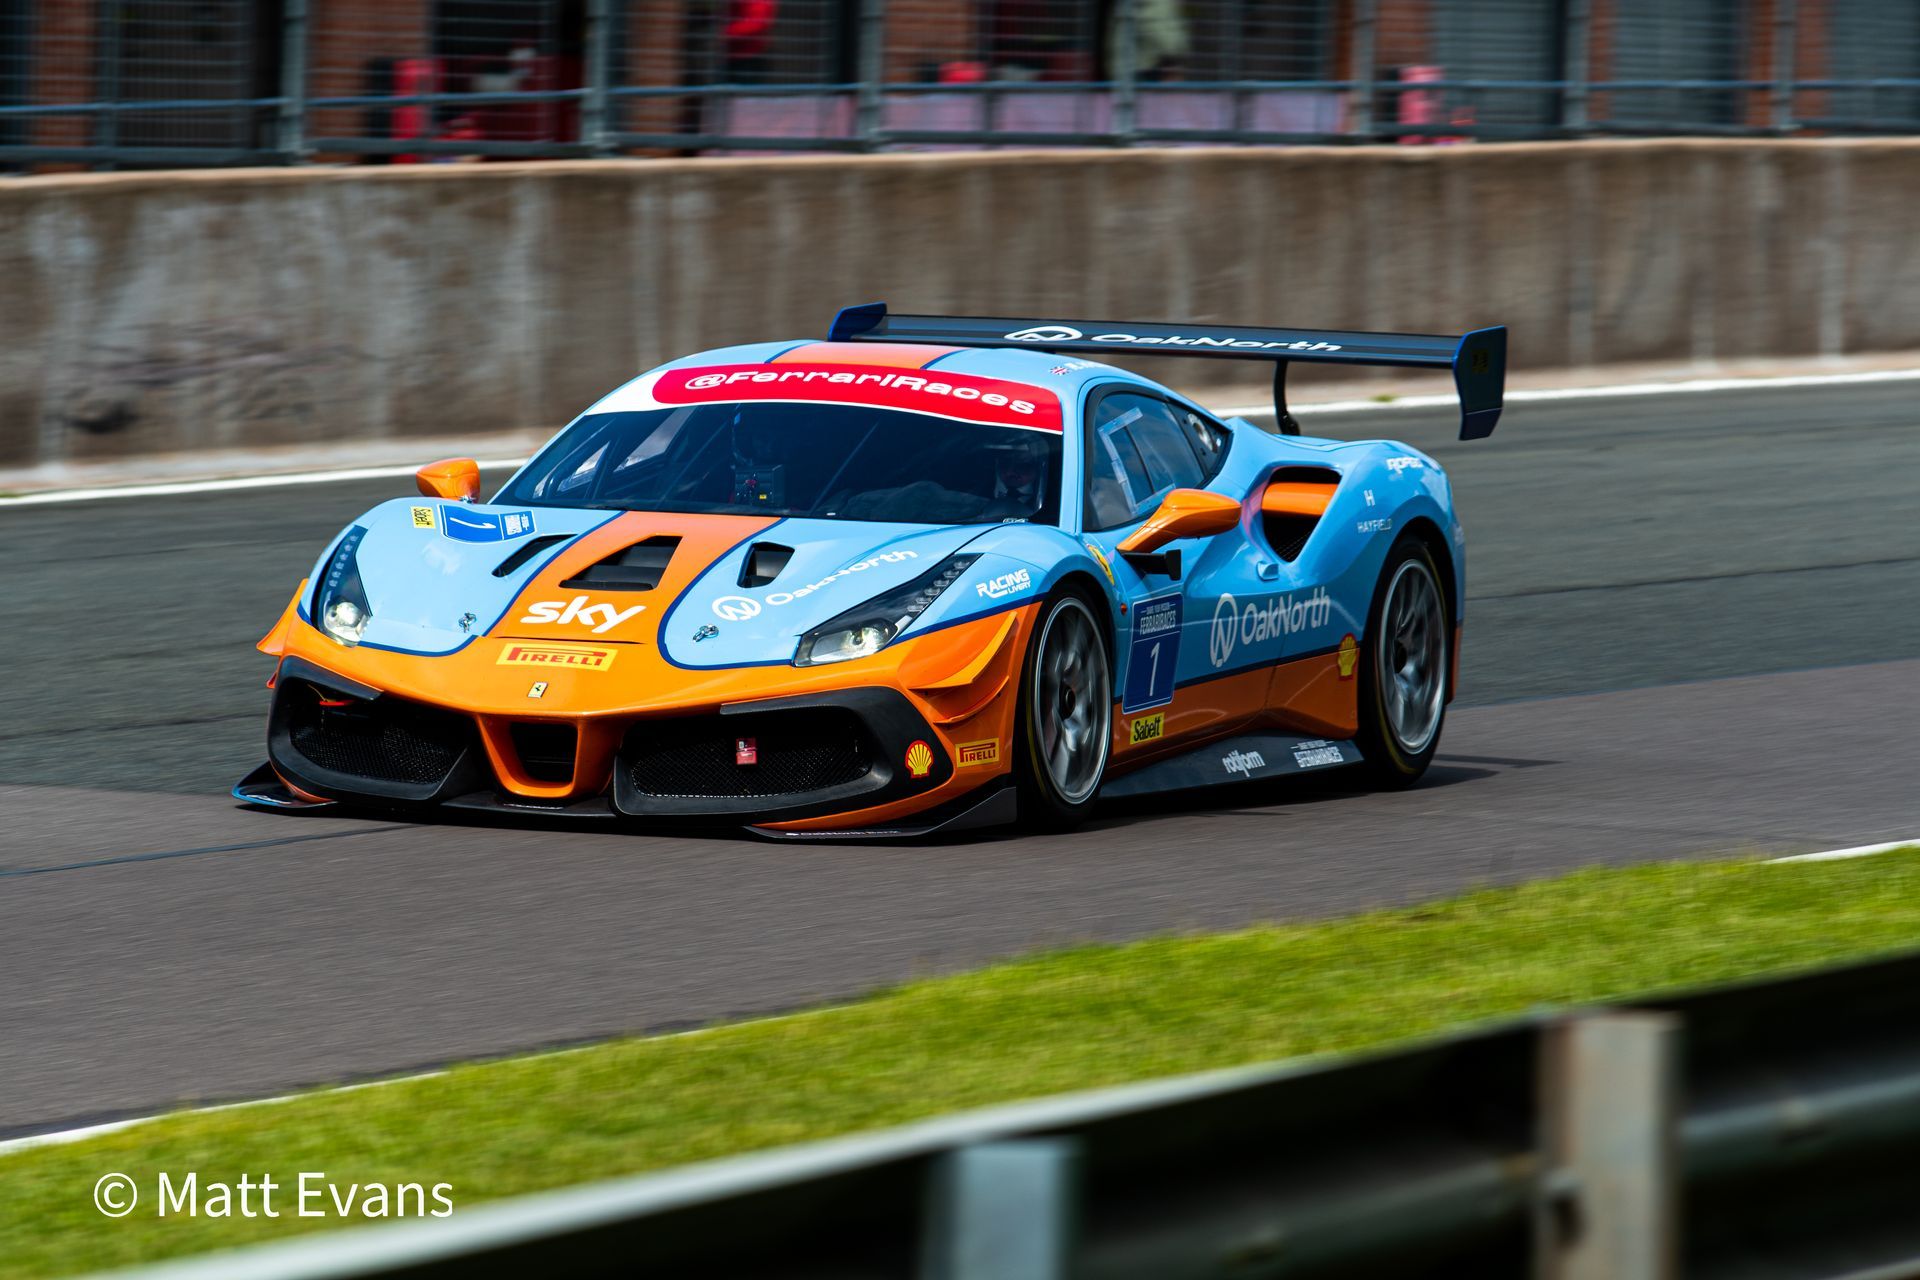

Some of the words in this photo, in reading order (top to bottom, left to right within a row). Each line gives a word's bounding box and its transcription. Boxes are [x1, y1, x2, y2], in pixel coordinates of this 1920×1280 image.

[1091, 333, 1343, 352] OakNorth
[1363, 489, 1376, 507] H
[765, 550, 918, 606] OakNorth
[976, 568, 1030, 598] RACING
[1008, 580, 1031, 594] LIVERY
[520, 595, 647, 634] sky
[1241, 586, 1332, 645] OakNorth
[507, 647, 608, 667] PIRELLI
[1149, 641, 1161, 697] 1
[1133, 715, 1161, 742] Sabelt
[959, 742, 996, 763] PIRELLI
